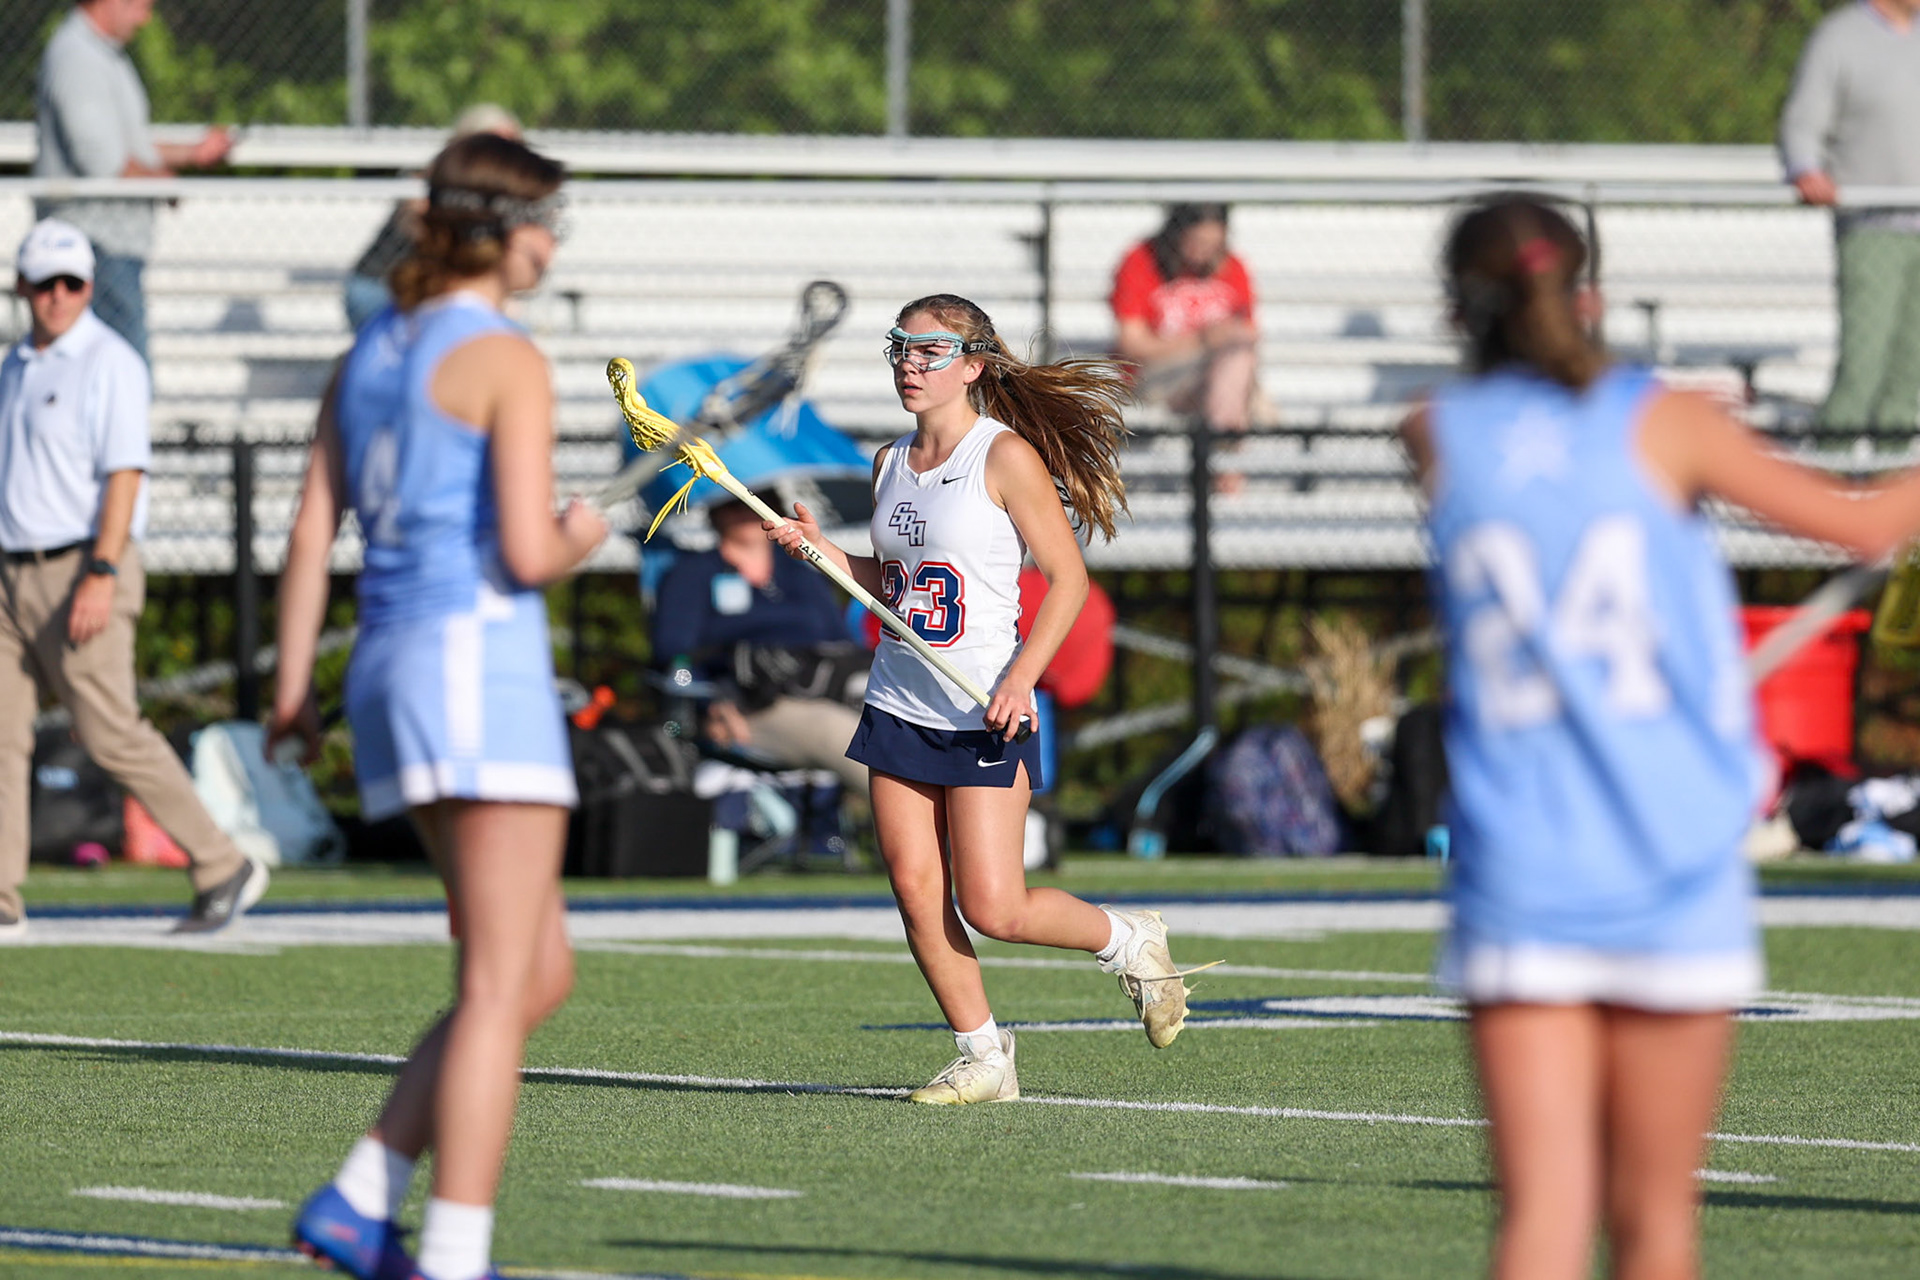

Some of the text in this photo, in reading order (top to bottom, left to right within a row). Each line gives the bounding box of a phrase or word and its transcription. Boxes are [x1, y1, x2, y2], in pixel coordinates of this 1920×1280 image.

[889, 502, 926, 546] SBA
[881, 560, 966, 647] 23
[1451, 514, 1670, 724] 24
